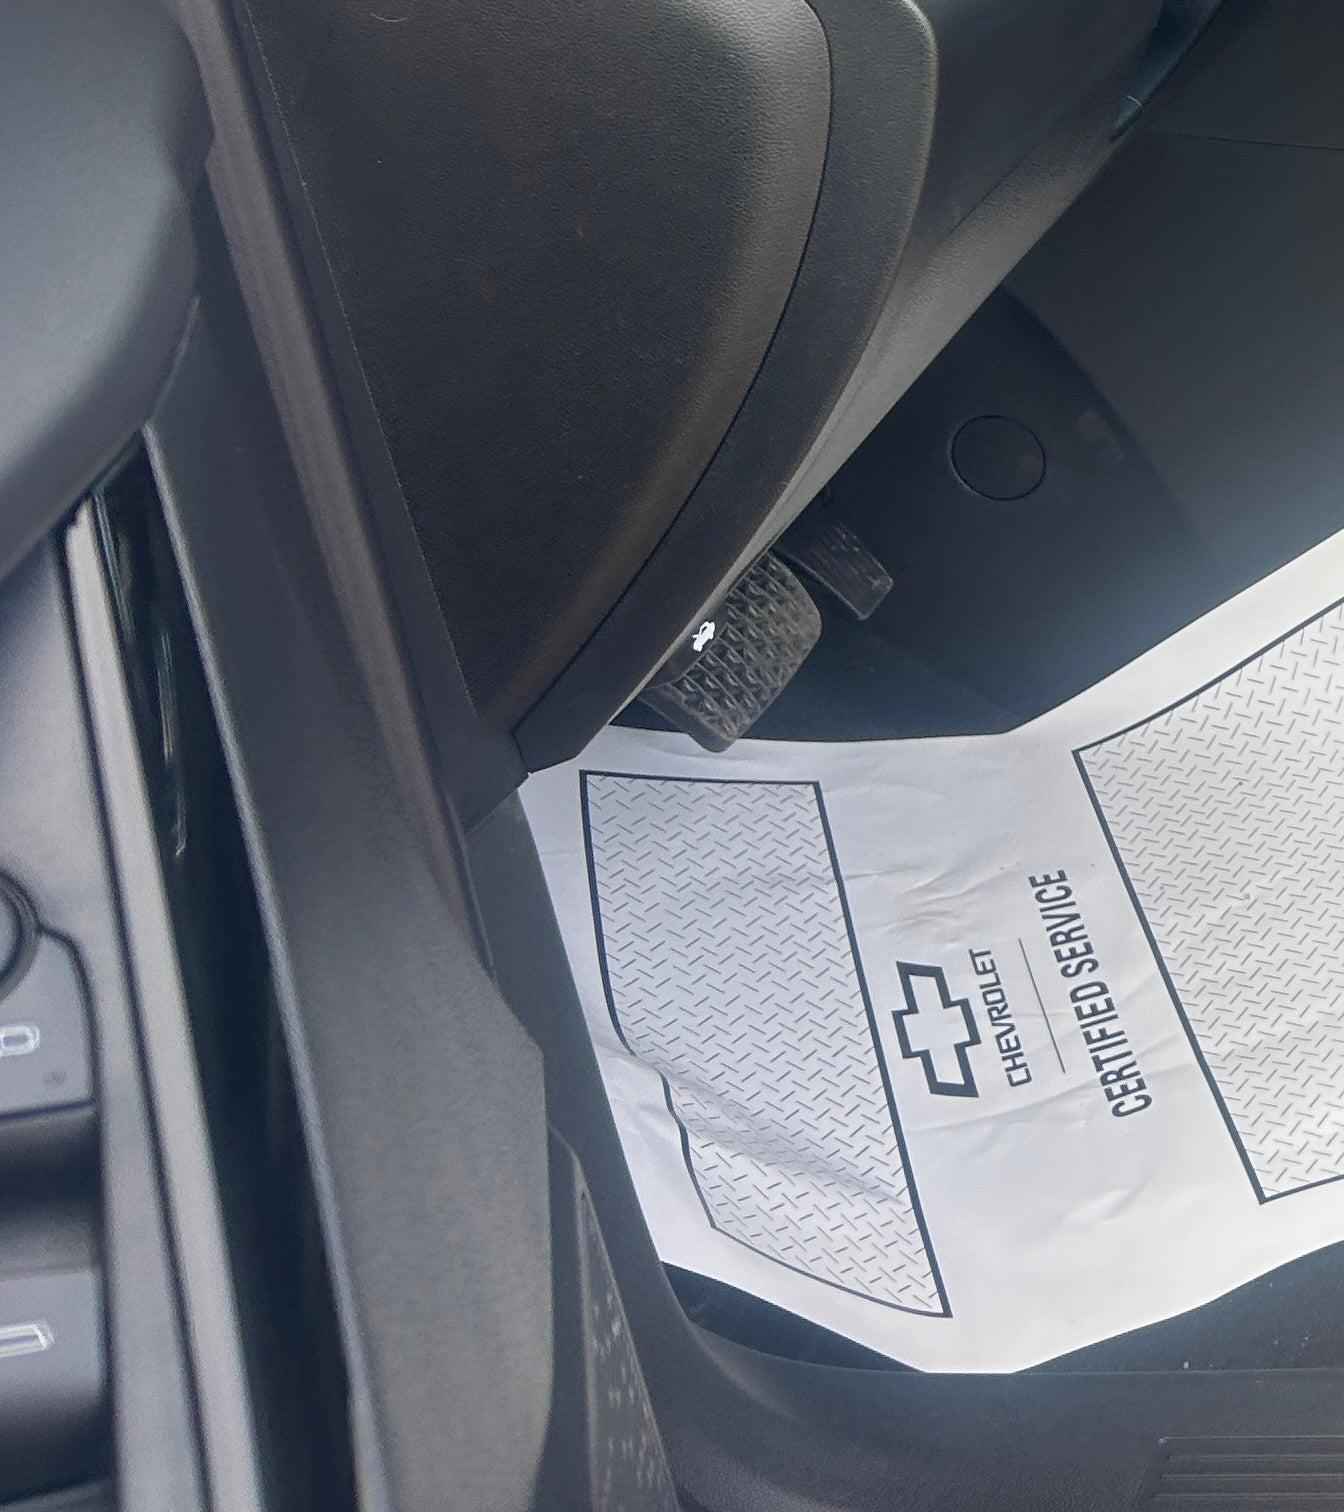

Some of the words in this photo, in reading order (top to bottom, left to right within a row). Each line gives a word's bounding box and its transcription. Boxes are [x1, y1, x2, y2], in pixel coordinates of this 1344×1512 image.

[1028, 869, 1099, 979] SERVICE
[968, 948, 1032, 1087] CHEVROLET
[1069, 981, 1152, 1118] CERTIFIED
